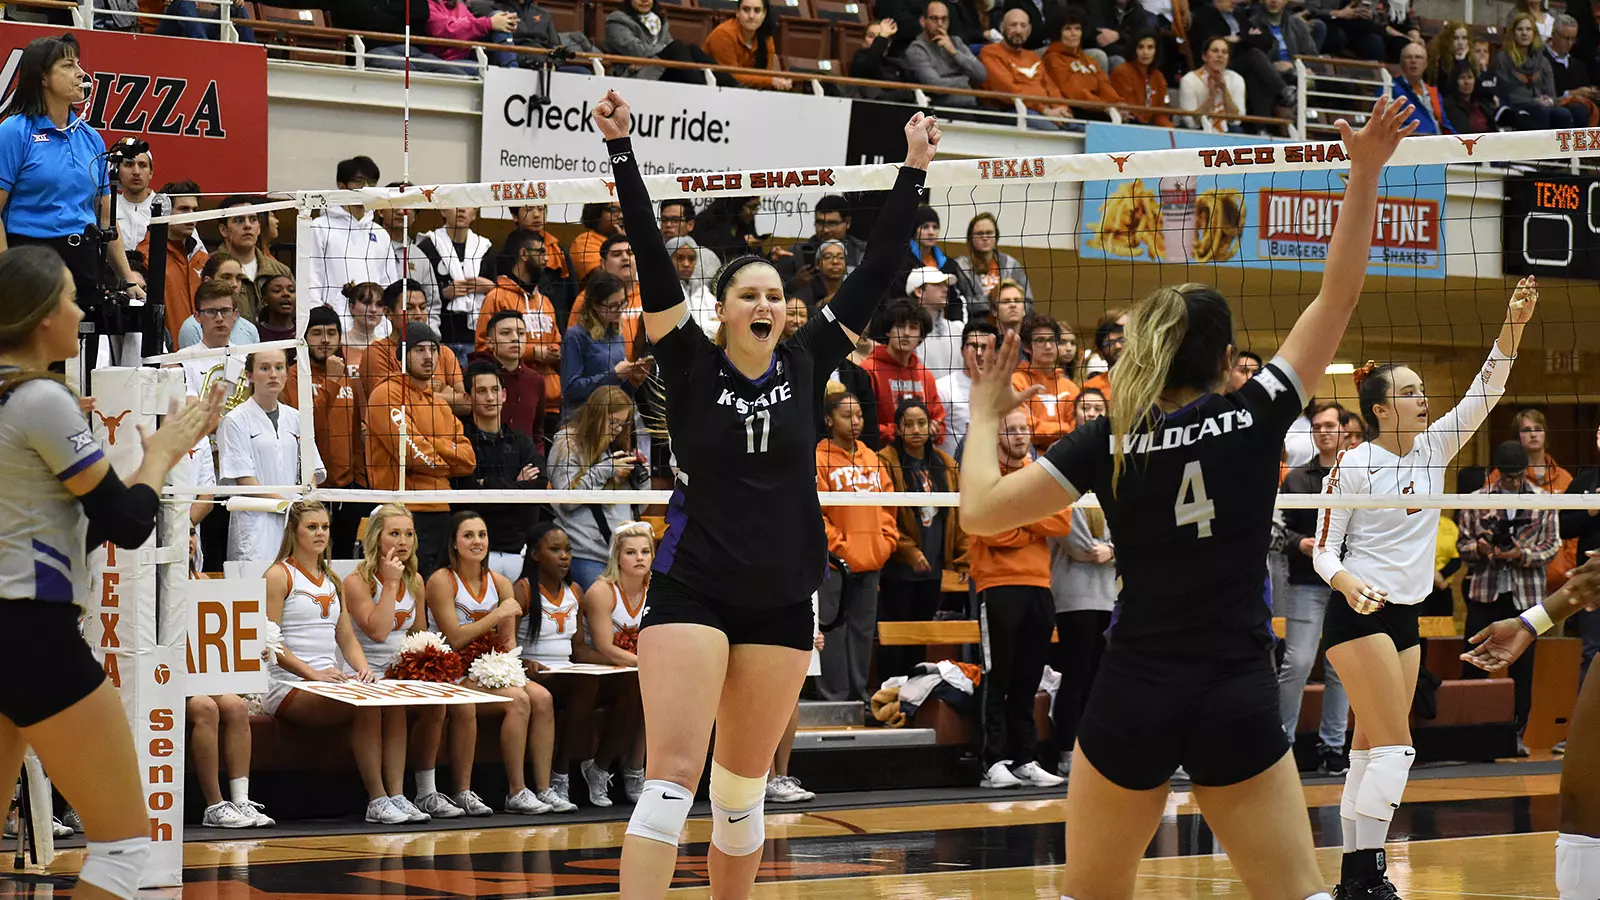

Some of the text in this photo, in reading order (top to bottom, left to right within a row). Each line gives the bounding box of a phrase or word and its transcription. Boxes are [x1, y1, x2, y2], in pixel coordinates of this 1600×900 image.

[504, 94, 595, 133] Check
[670, 109, 730, 144] ride:
[500, 149, 579, 172] Remember
[582, 160, 596, 173] to
[643, 160, 665, 175] the
[978, 157, 1046, 179] TEXAS
[1199, 143, 1351, 168] TACO SHA
[491, 181, 547, 200] TEXAS
[677, 173, 742, 192] TACO
[750, 168, 836, 189] SHACK
[1534, 181, 1580, 210] TEXAS
[1267, 195, 1431, 246] MIGH FINE
[744, 409, 771, 453] 17
[1109, 408, 1254, 455] WILDCATS
[1174, 460, 1215, 539] 4
[99, 540, 122, 688] TEXA
